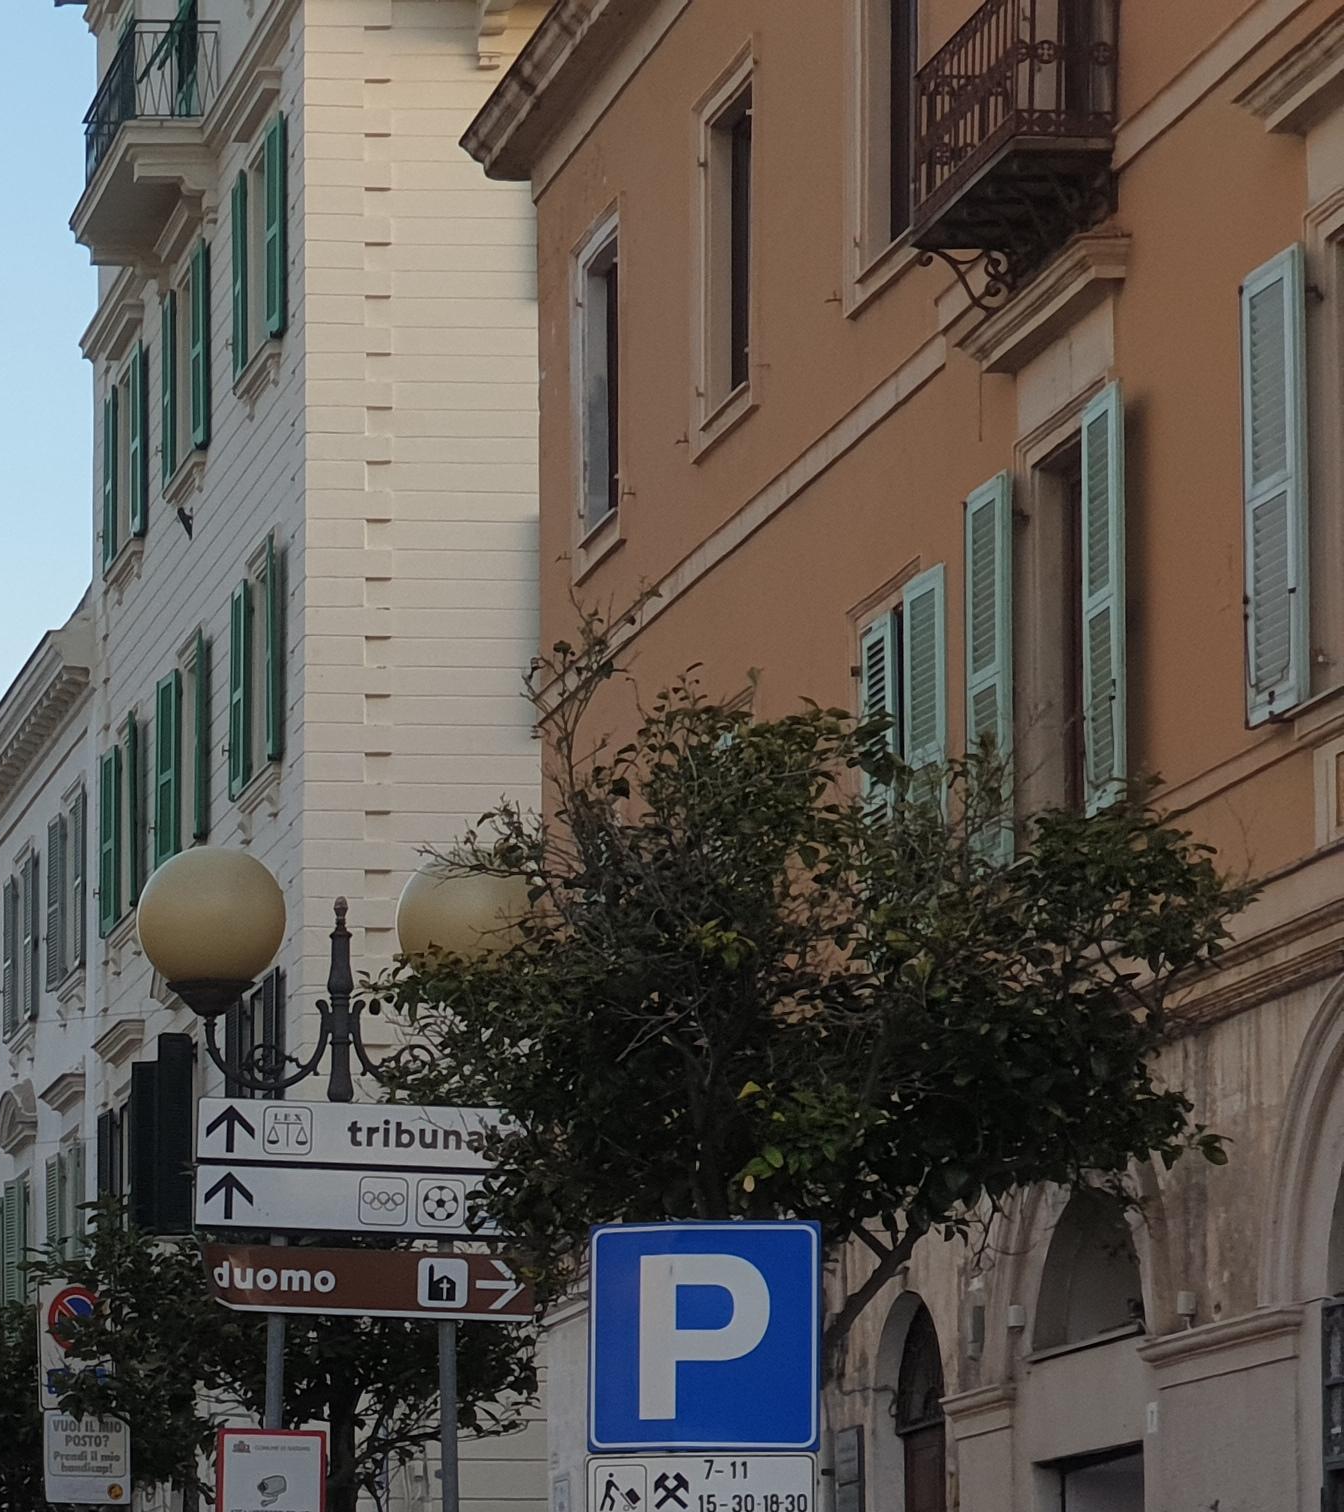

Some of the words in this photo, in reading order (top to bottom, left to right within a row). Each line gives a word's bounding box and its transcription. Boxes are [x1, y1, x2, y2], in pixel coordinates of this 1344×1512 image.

[273, 1112, 302, 1122] LEX
[213, 1260, 337, 1293] duomo
[639, 1254, 771, 1421] P
[52, 1419, 81, 1433] VUOI
[84, 1420, 95, 1433] IL
[99, 1420, 123, 1434] MIO
[64, 1434, 110, 1448] POSTO?
[53, 1450, 87, 1462] Prendi
[100, 1451, 121, 1462] mio
